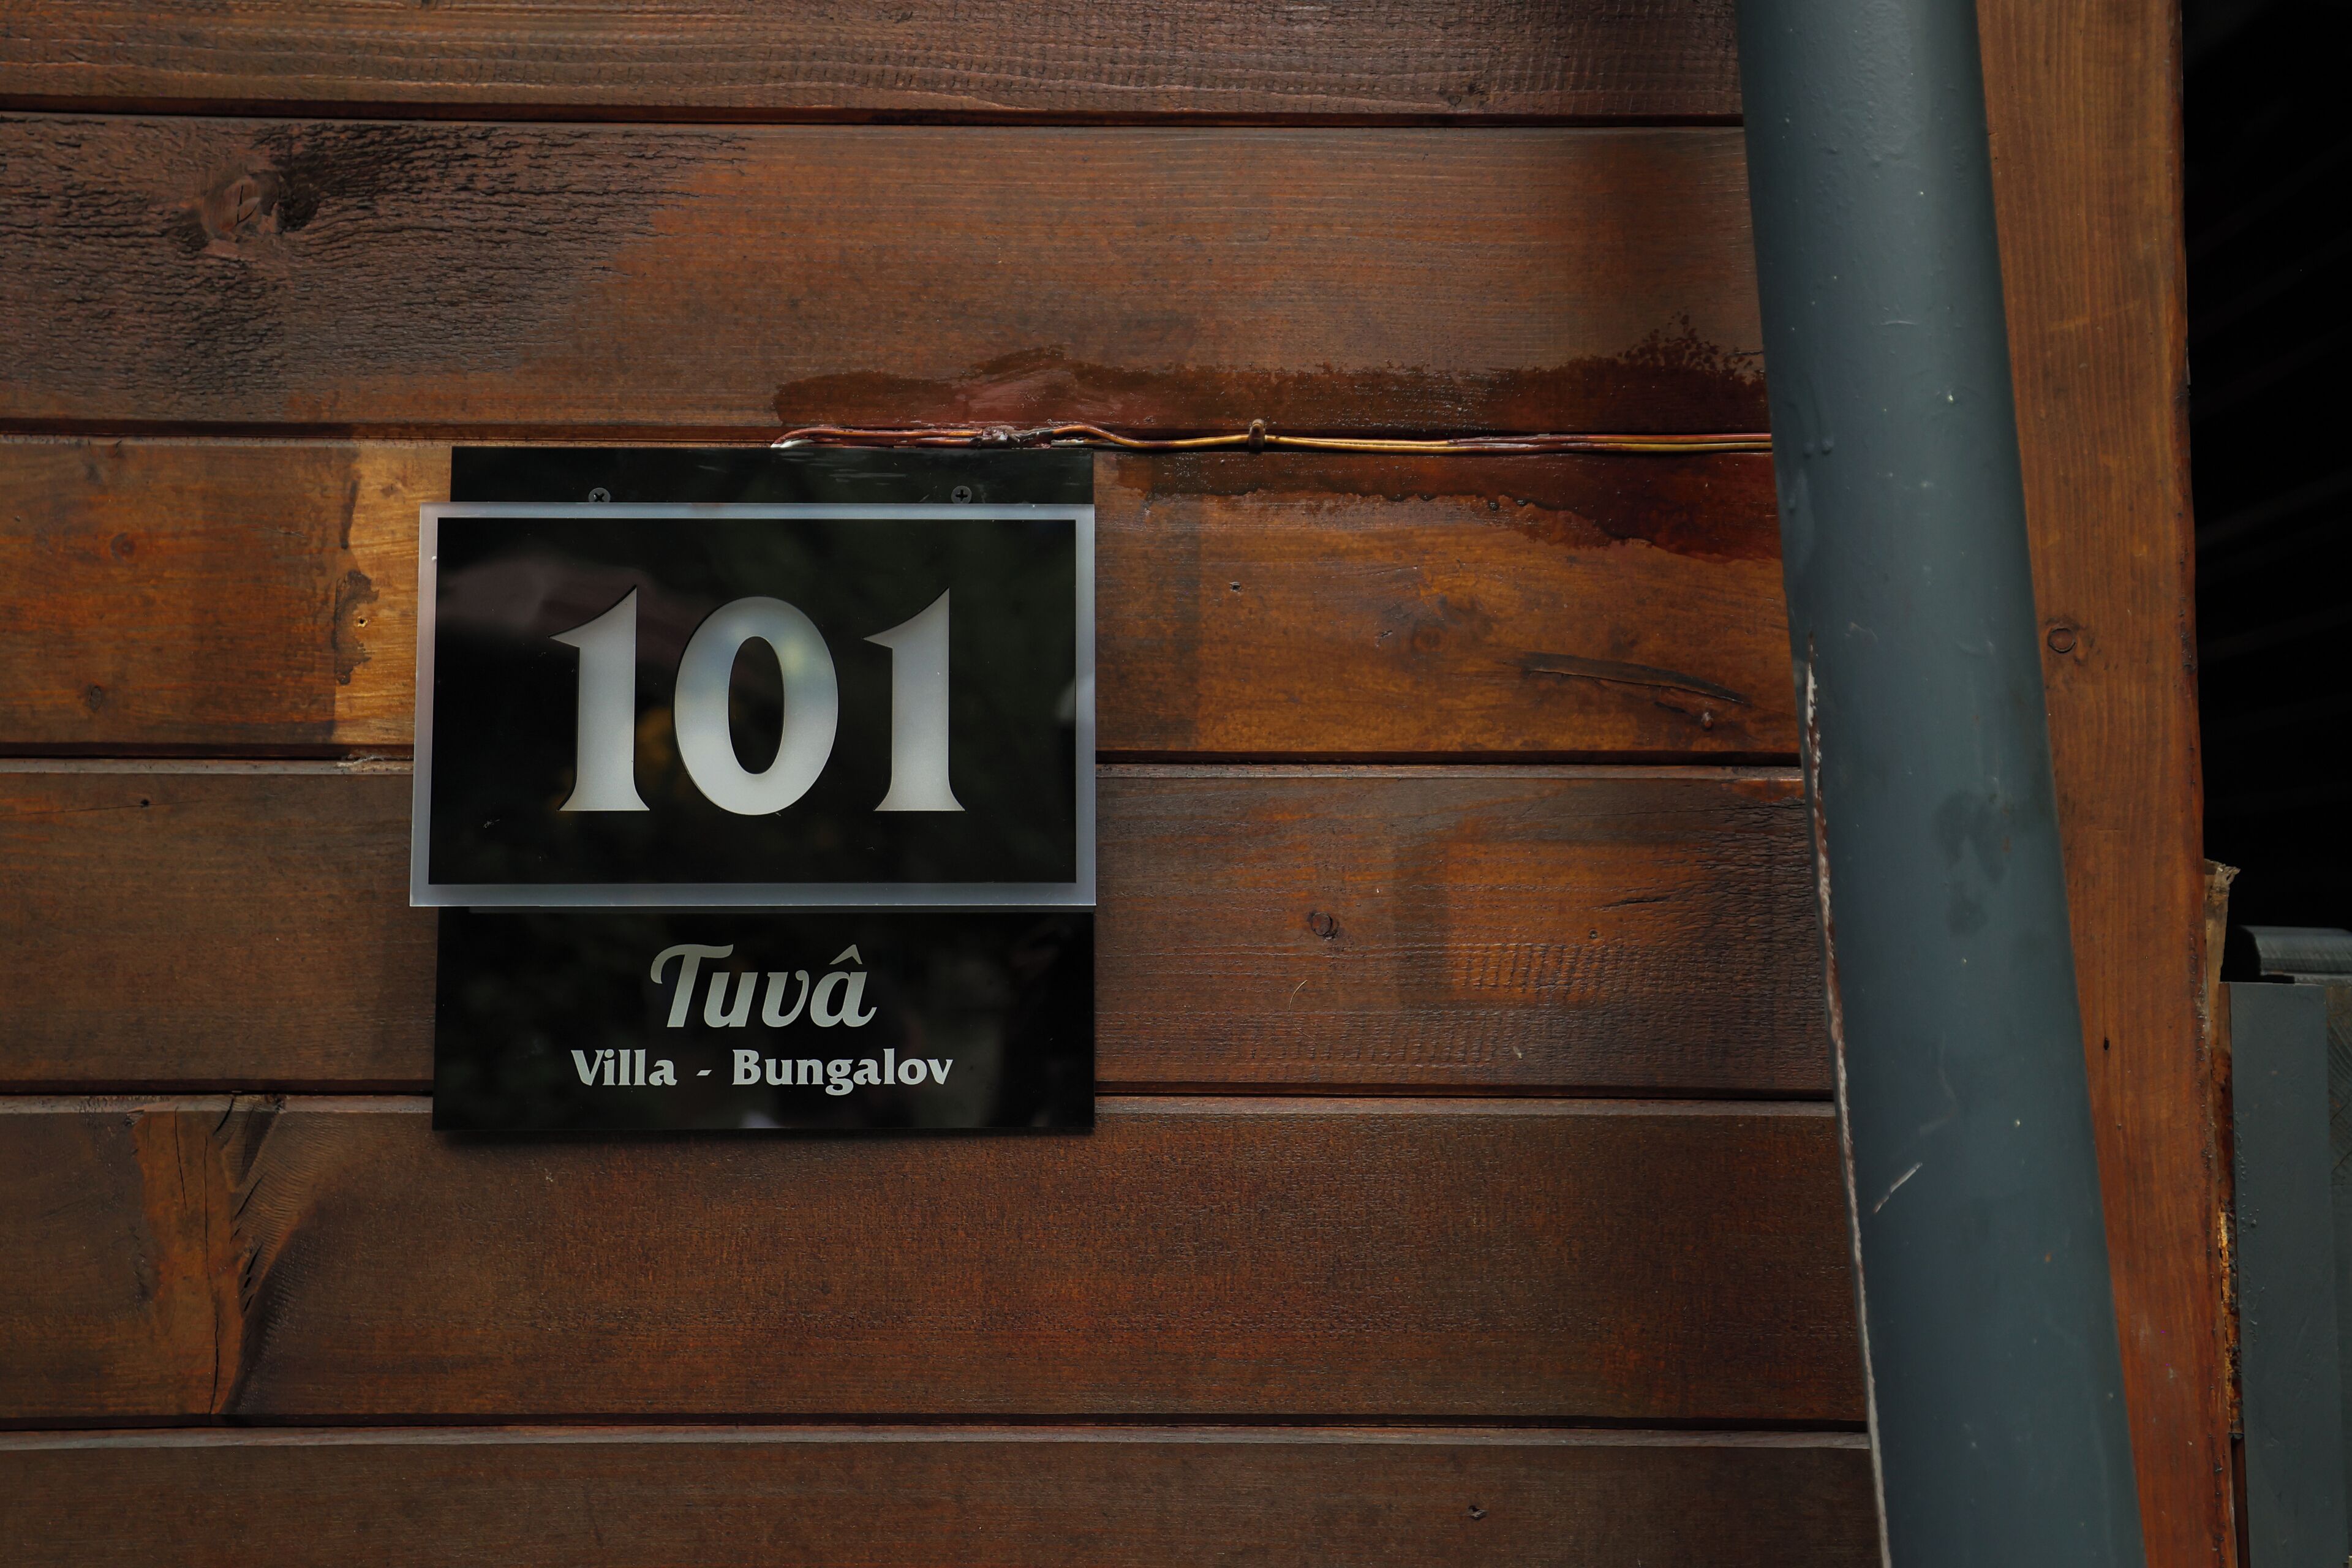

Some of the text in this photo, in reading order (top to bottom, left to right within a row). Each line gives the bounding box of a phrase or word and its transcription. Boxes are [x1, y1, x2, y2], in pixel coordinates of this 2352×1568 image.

[549, 586, 966, 816] 101
[650, 943, 877, 1028] Tuvâ
[570, 1049, 678, 1086] Villa
[731, 1048, 953, 1096] Bungalov
